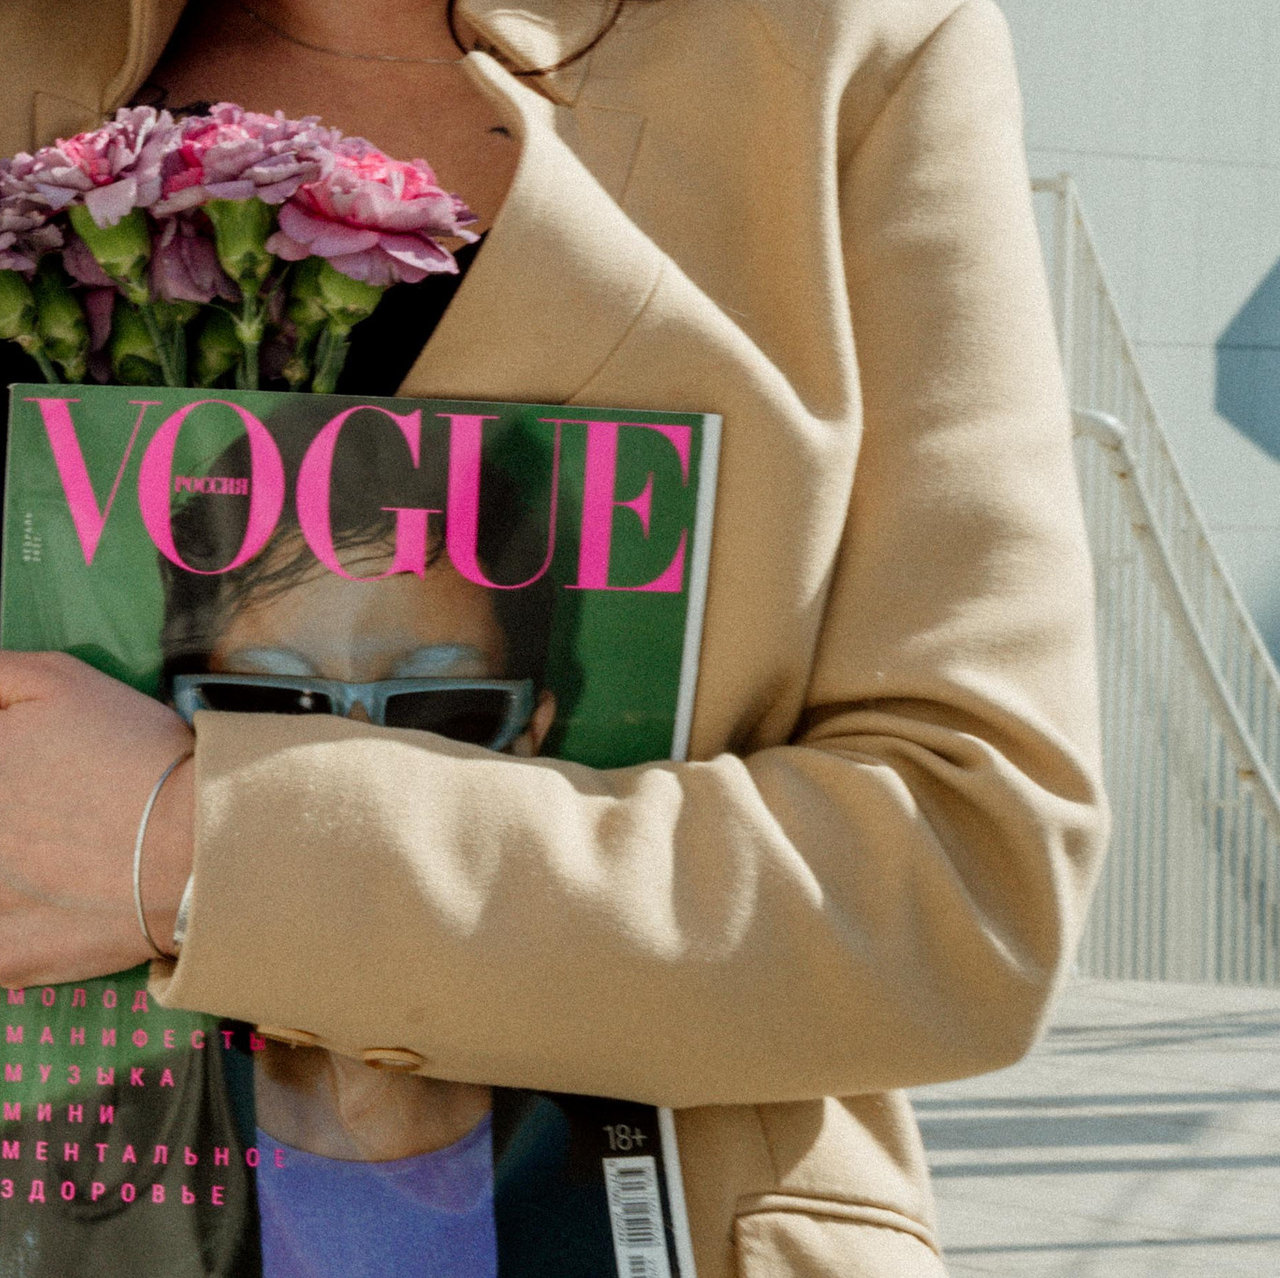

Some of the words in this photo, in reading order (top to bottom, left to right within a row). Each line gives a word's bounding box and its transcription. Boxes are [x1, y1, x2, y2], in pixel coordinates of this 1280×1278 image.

[23, 397, 693, 594] VOGUE
[175, 475, 249, 496] РОССИЯ
[6, 987, 149, 1013] МОЛОД
[5, 1025, 266, 1051] МАНИФЕСТЫ
[4, 1064, 175, 1087] МУЗЫКА
[3, 1102, 114, 1124] МИНИ
[602, 1124, 648, 1151] 18+
[2, 1140, 286, 1169] МЕНТАЛЬНОЕ
[0, 1178, 225, 1206] ЗДОРОВЬЕ
